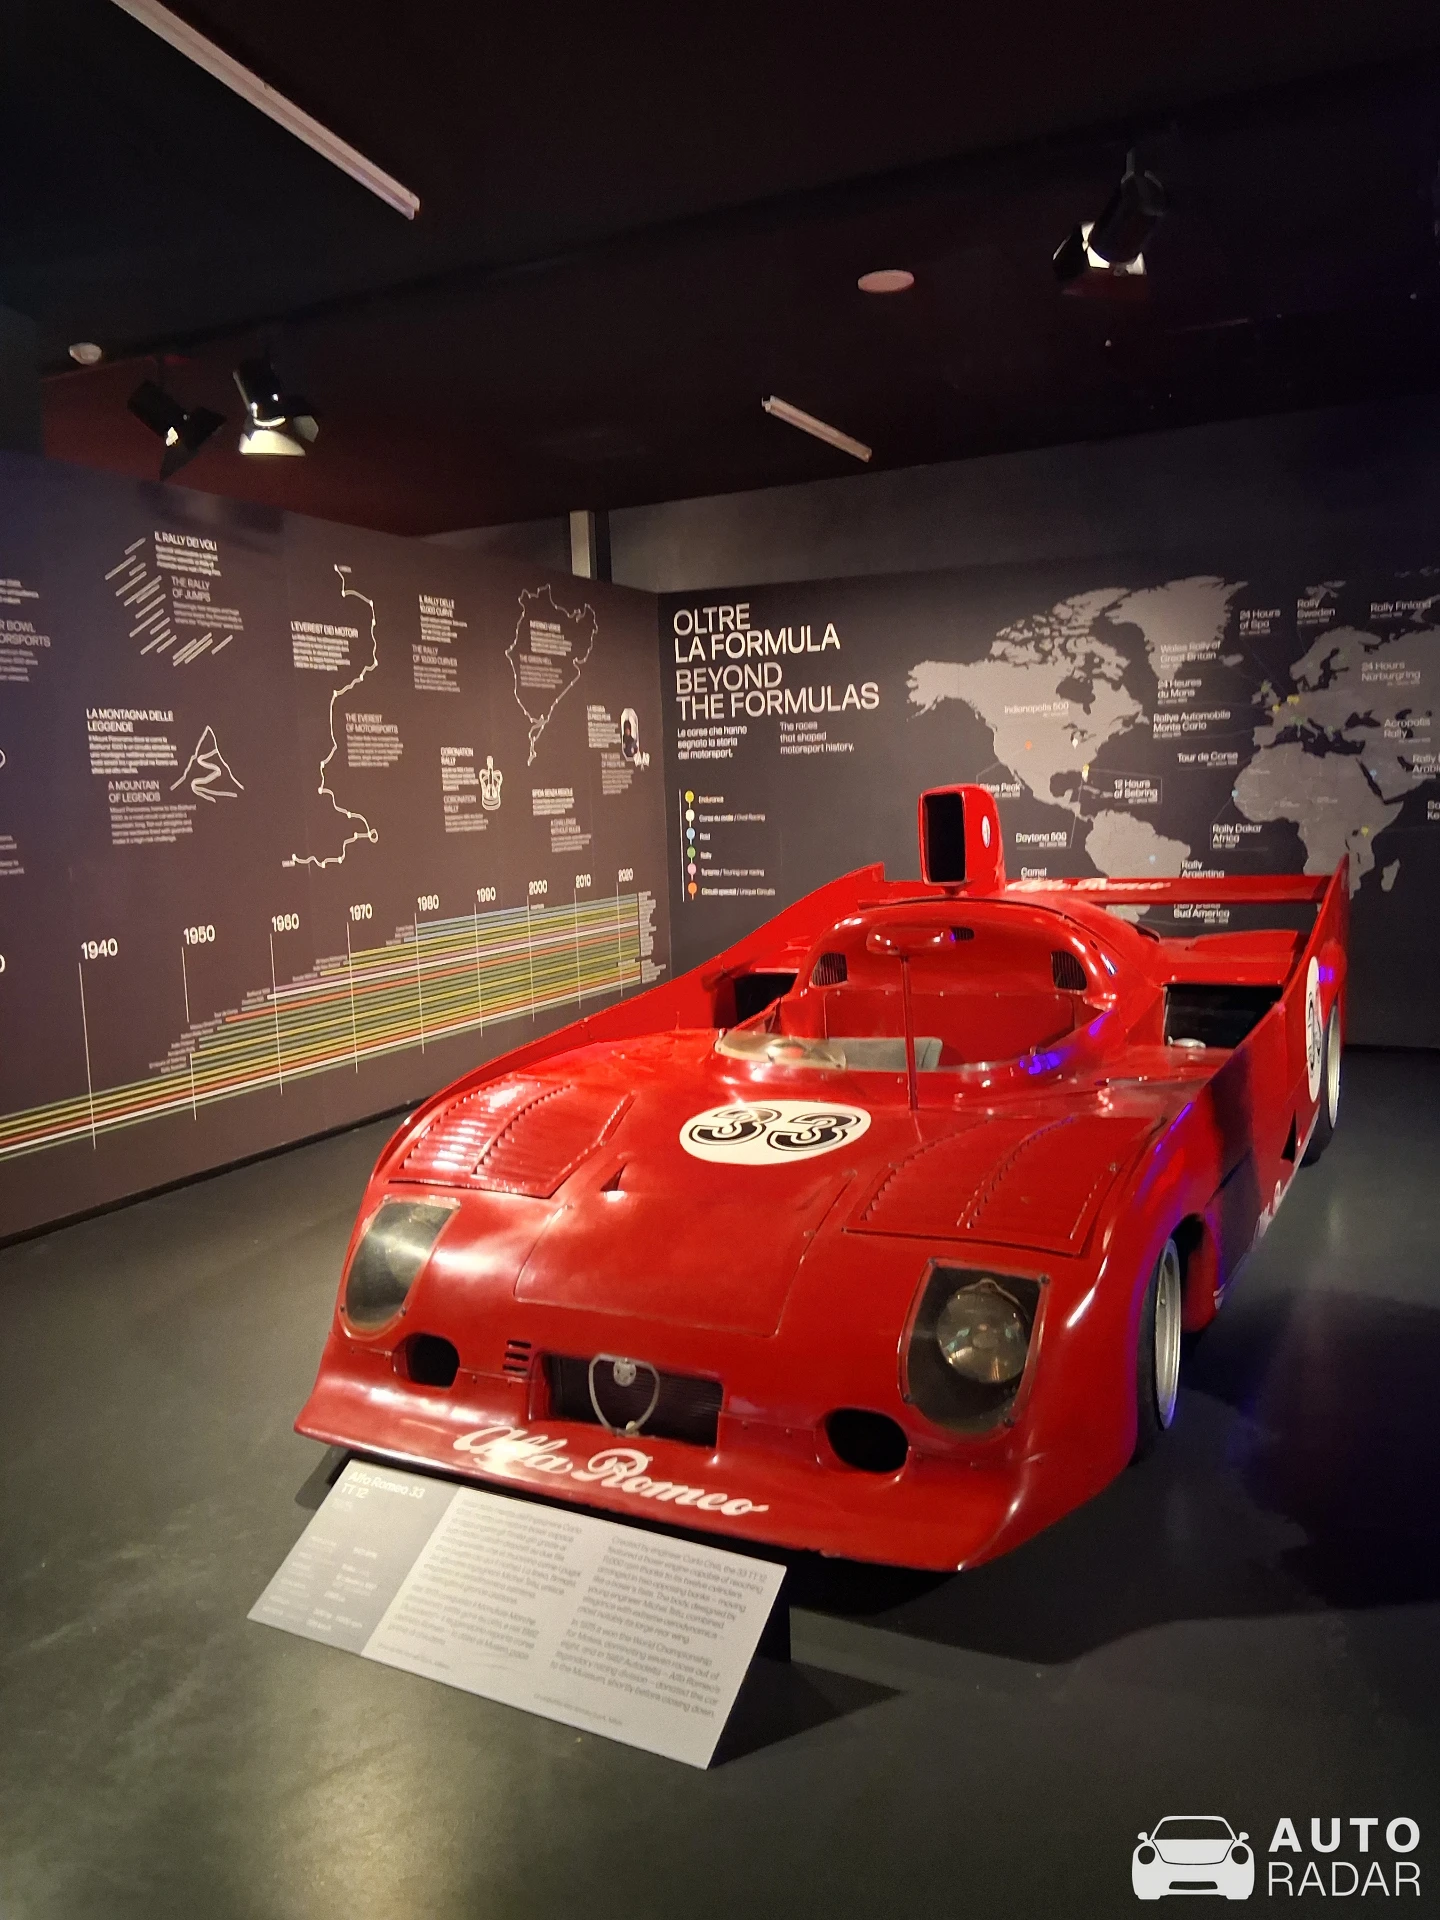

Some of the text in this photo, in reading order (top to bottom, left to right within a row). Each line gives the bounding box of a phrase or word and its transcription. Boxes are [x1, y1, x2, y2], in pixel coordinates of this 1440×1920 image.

[162, 532, 185, 545] RALLY
[188, 577, 210, 590] RALLY
[172, 587, 184, 598] OF
[1297, 599, 1319, 608] Rally
[1371, 599, 1431, 613] Rally Finland
[673, 602, 750, 636] OLTRE
[1253, 609, 1281, 619] Hours
[1297, 608, 1335, 618] Sweden
[7, 620, 36, 633] BOWL
[1239, 621, 1249, 630] of
[675, 623, 841, 663] LA FORMULA
[1376, 661, 1405, 669] Hours
[676, 662, 783, 695] BEYOND
[1158, 689, 1195, 699] du Mans
[676, 682, 880, 721] THE FORMULAS
[1005, 703, 1051, 714] Indianapolis
[86, 708, 173, 722] LA MONTAGNA DELLE
[1181, 710, 1230, 721] Automobile
[87, 720, 133, 732] LEGGENDE
[780, 722, 794, 731] The
[1153, 722, 1206, 732] Monte Carlo
[1385, 718, 1430, 728] Acropolis
[723, 725, 747, 735] hanno
[780, 732, 827, 743] that shaped
[780, 743, 855, 755] motorsport history.
[1178, 751, 1238, 763] Tour de Corse
[108, 780, 160, 790] A MOUNTAIN
[1001, 782, 1021, 792] Peak
[1125, 779, 1150, 788] Hours
[108, 792, 160, 803] OF LEGENDS
[1114, 788, 1158, 801] of Sebring
[1213, 823, 1262, 834] Rally Dakar
[1016, 832, 1049, 844] Daytona
[1213, 834, 1239, 843] Africa
[1181, 860, 1202, 870] Rally
[618, 867, 633, 883] 2020
[1021, 867, 1047, 877] Camel
[1182, 870, 1225, 878] Argentina
[528, 879, 547, 895] 2000
[576, 873, 591, 889] 2010
[477, 886, 496, 903] 1990
[417, 894, 439, 912] 1980
[350, 903, 373, 921] 1970
[1192, 909, 1230, 918] America
[271, 913, 299, 932] 1960
[183, 924, 215, 945] 1950
[81, 938, 118, 960] 1940
[689, 1106, 861, 1151] 33
[348, 1471, 425, 1499] Alfa Romeo 33
[571, 1448, 769, 1516] Romeo
[355, 1487, 369, 1499] 12
